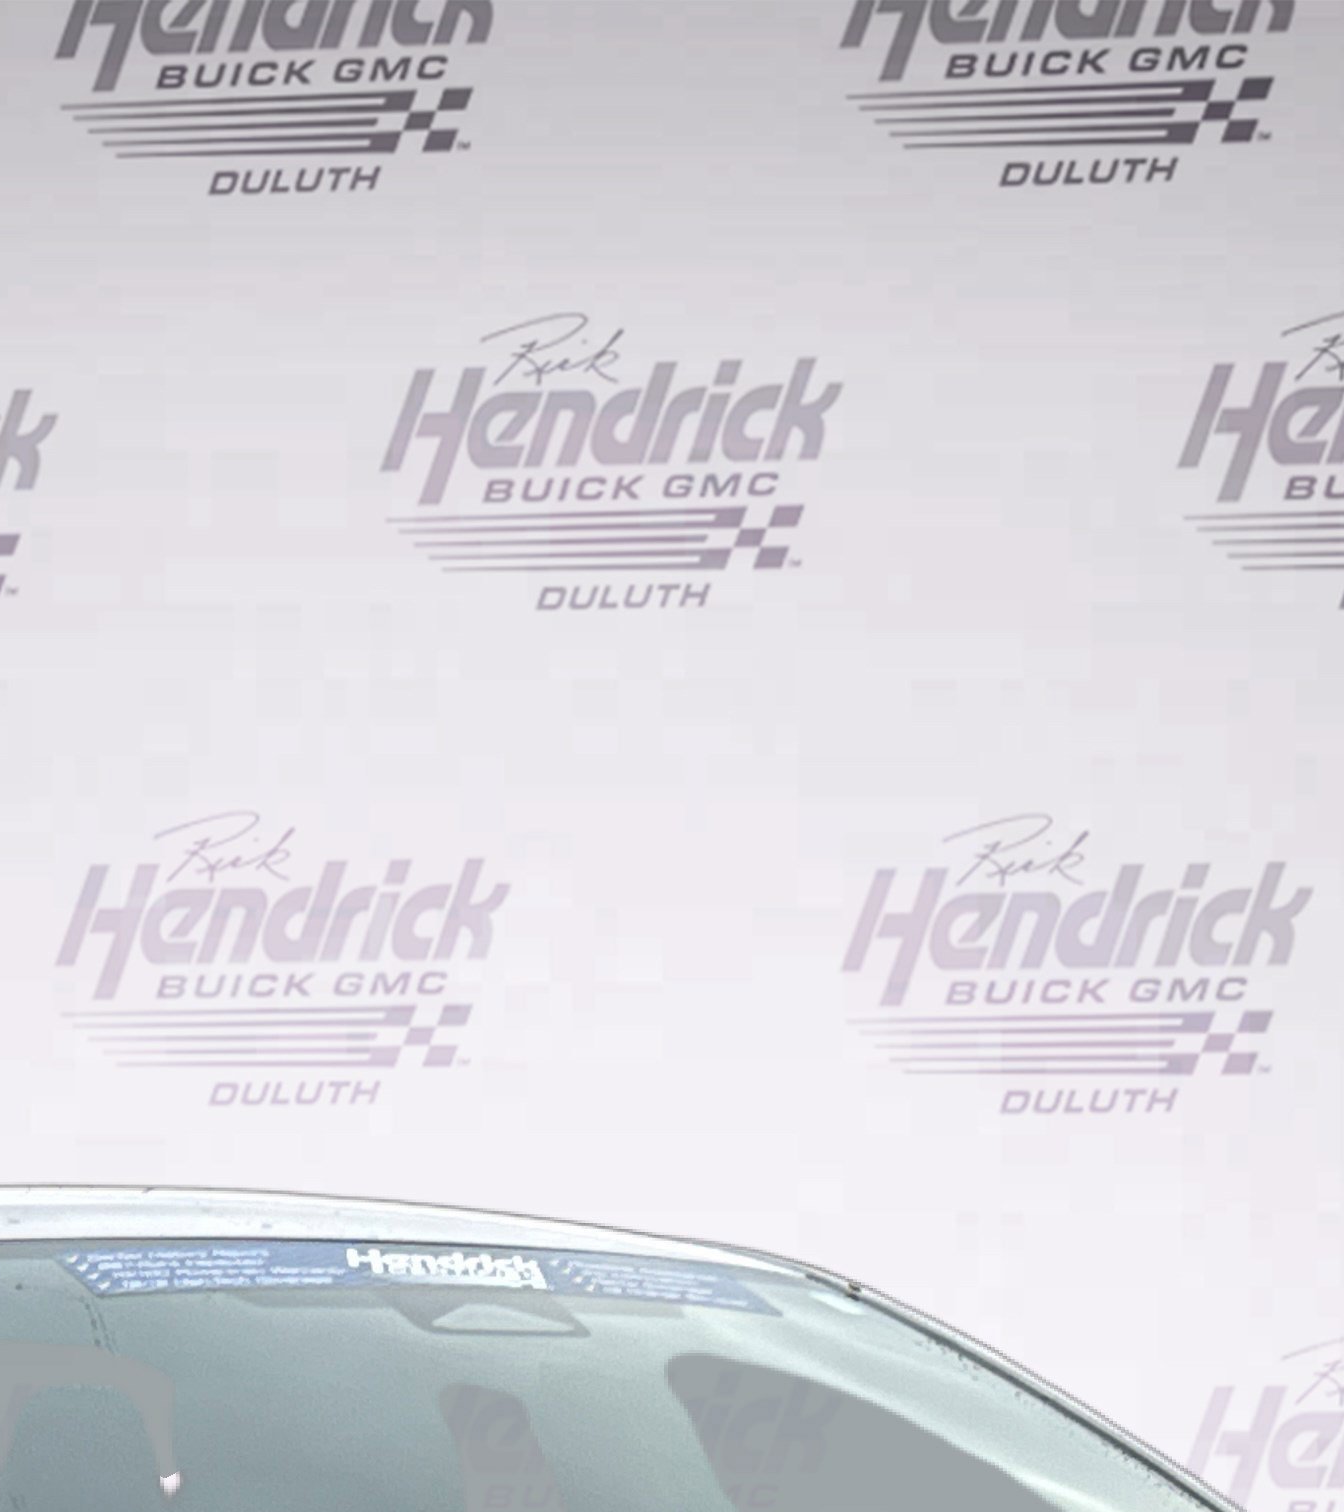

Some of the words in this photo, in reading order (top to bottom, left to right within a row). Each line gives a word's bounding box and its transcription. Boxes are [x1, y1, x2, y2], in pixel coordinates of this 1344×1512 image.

[155, 60, 315, 90] BUICK
[333, 55, 449, 83] GMC
[944, 49, 1110, 79] BUICK
[1128, 44, 1248, 72] GMC
[208, 166, 382, 196] DULUTH
[999, 157, 1179, 187] DULUTH
[380, 357, 843, 506] Hendrick
[482, 474, 643, 503] BUICK
[662, 471, 780, 499] GMC
[536, 583, 711, 611] DULUTH
[56, 858, 510, 999] Hendrick
[841, 861, 1314, 1007] Hendrick
[156, 972, 314, 999] BUICK
[332, 970, 448, 997] GMC
[944, 977, 1110, 1006] BUICK
[1127, 975, 1248, 1003] GMC
[208, 1080, 381, 1106] DULUTH
[999, 1087, 1179, 1114] DULUTH
